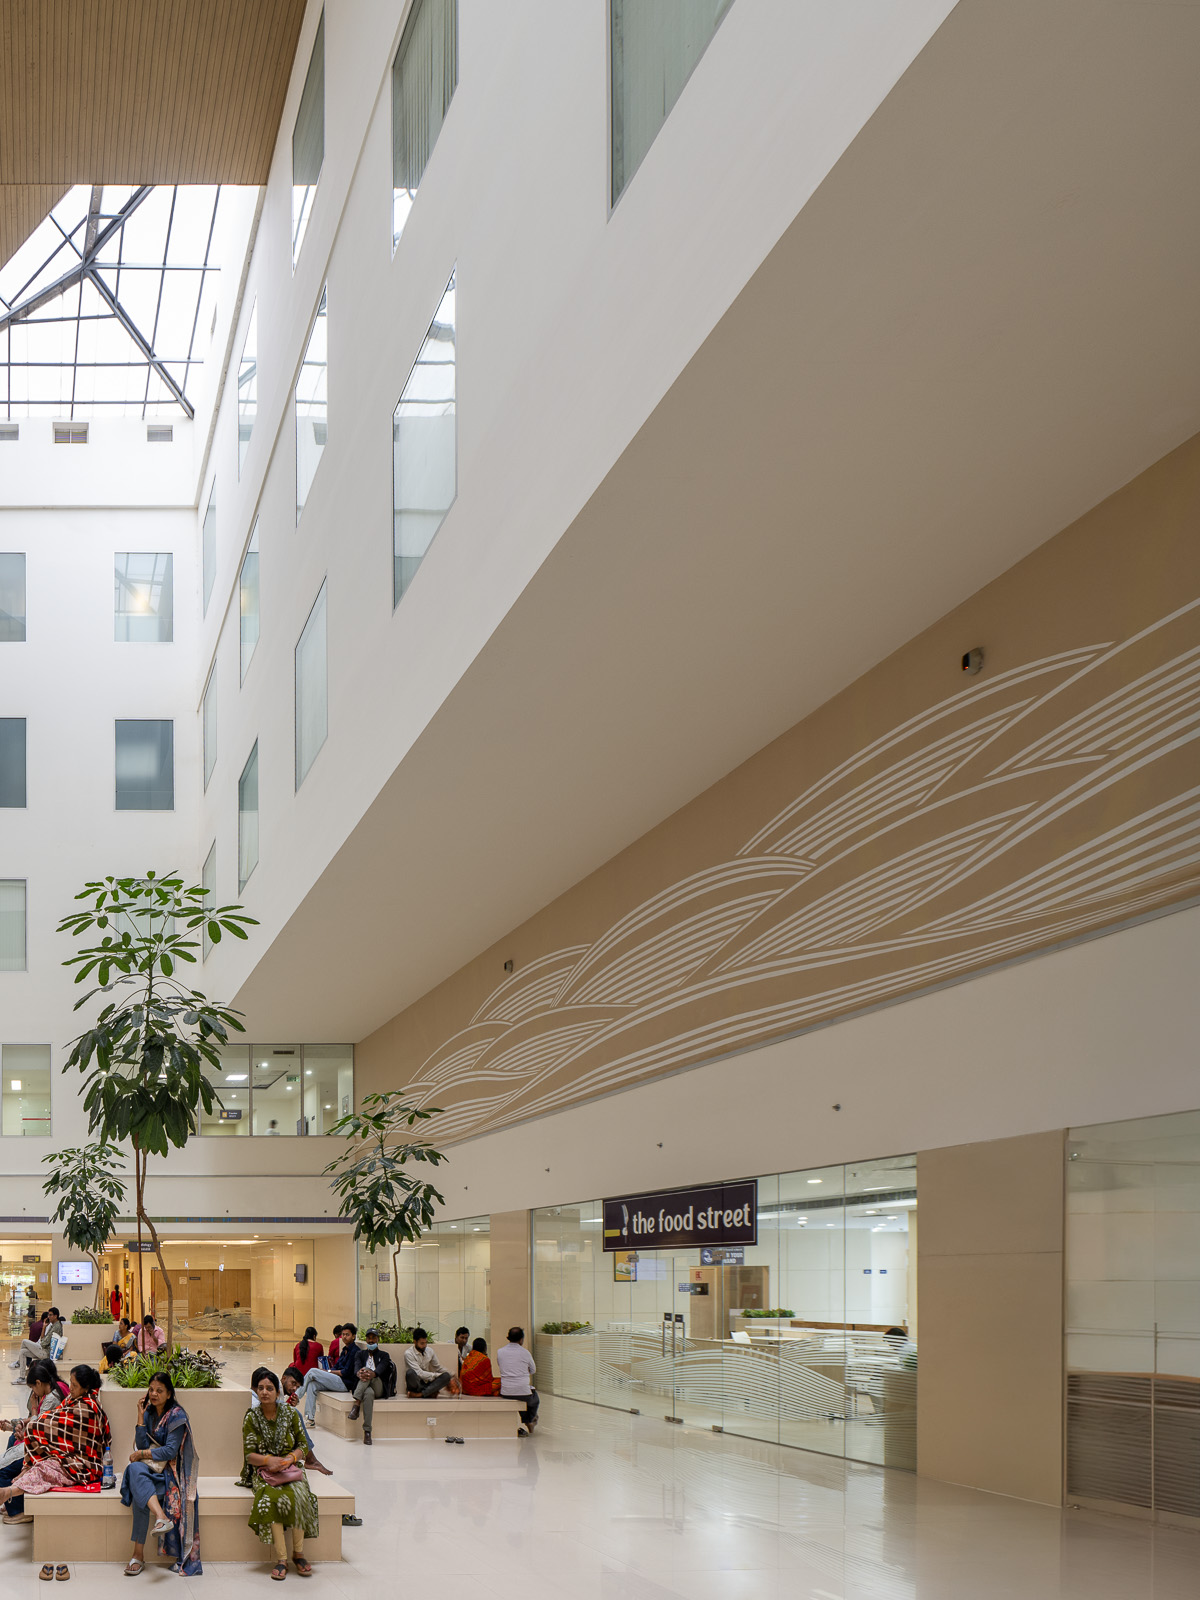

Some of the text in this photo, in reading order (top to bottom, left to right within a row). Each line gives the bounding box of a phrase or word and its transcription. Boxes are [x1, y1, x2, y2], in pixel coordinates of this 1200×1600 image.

[632, 1202, 752, 1235] the food street
